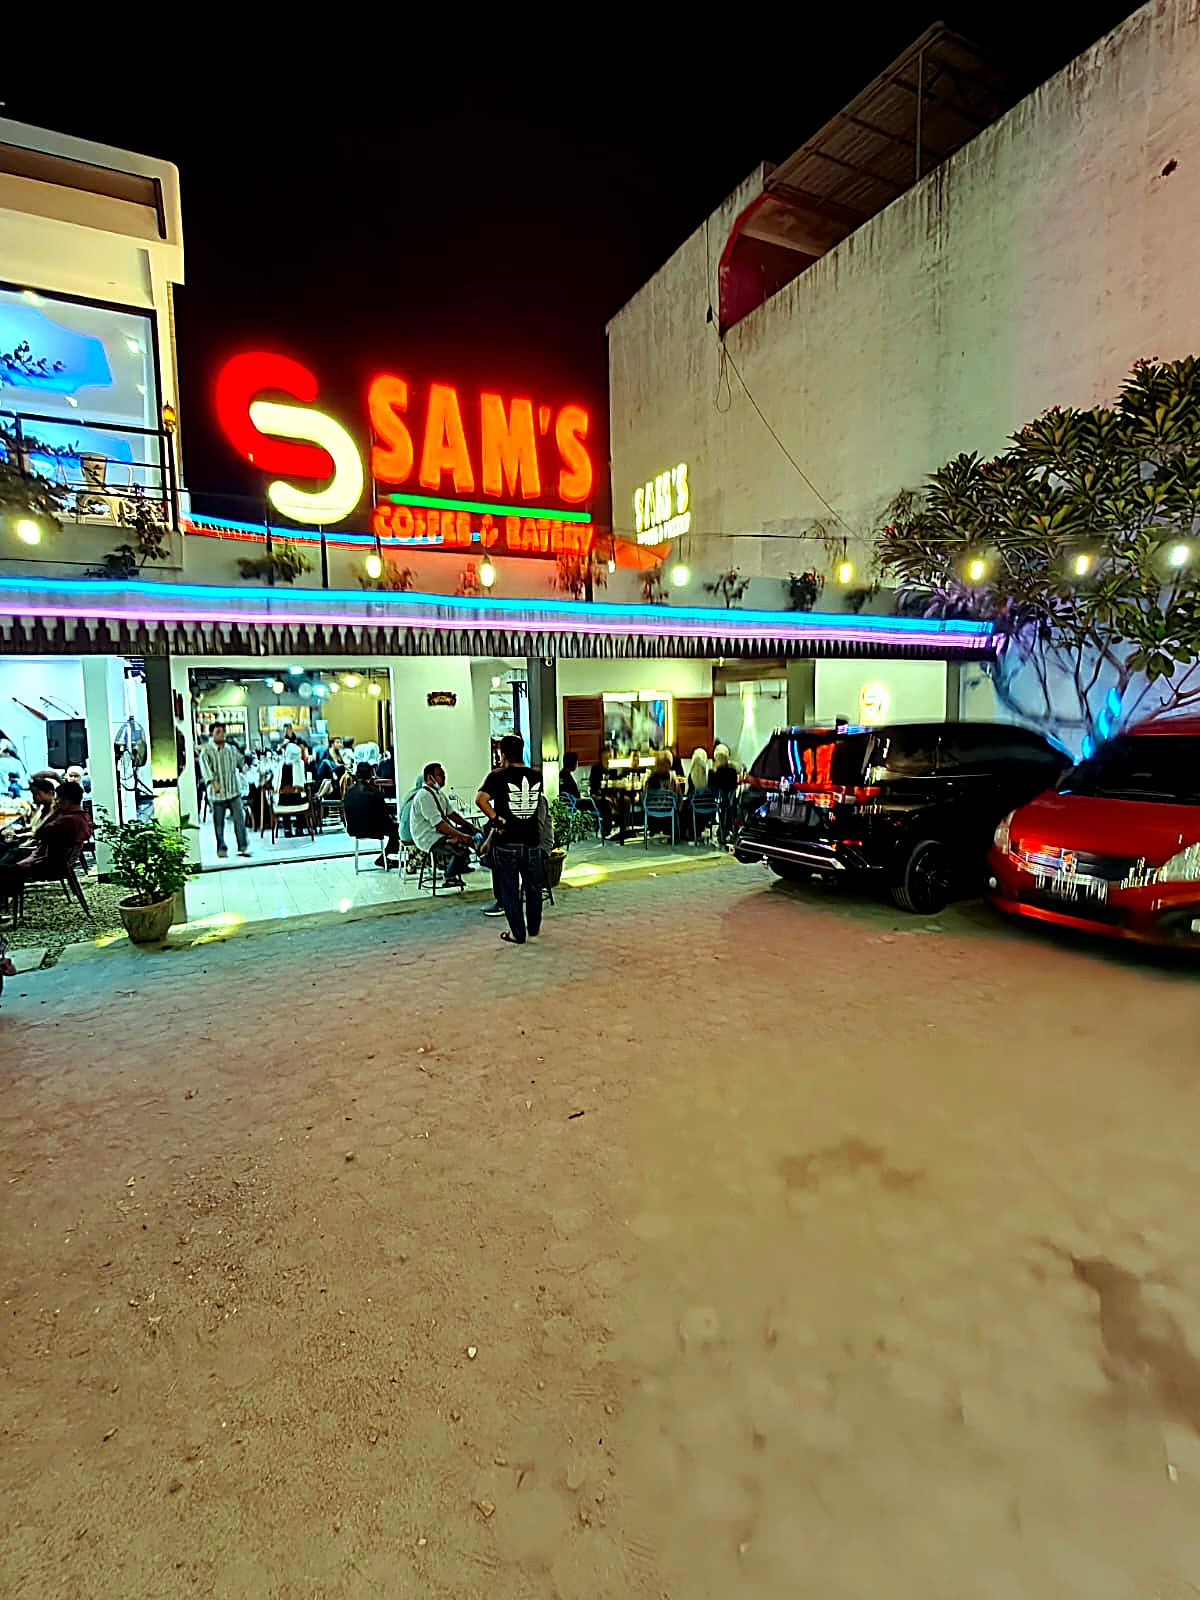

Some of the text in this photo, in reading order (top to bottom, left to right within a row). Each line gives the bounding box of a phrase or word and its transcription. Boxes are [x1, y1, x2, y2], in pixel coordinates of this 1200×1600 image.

[368, 373, 593, 504] SAM'S
[374, 505, 472, 548] COFFEE
[634, 463, 689, 534] SAM'S
